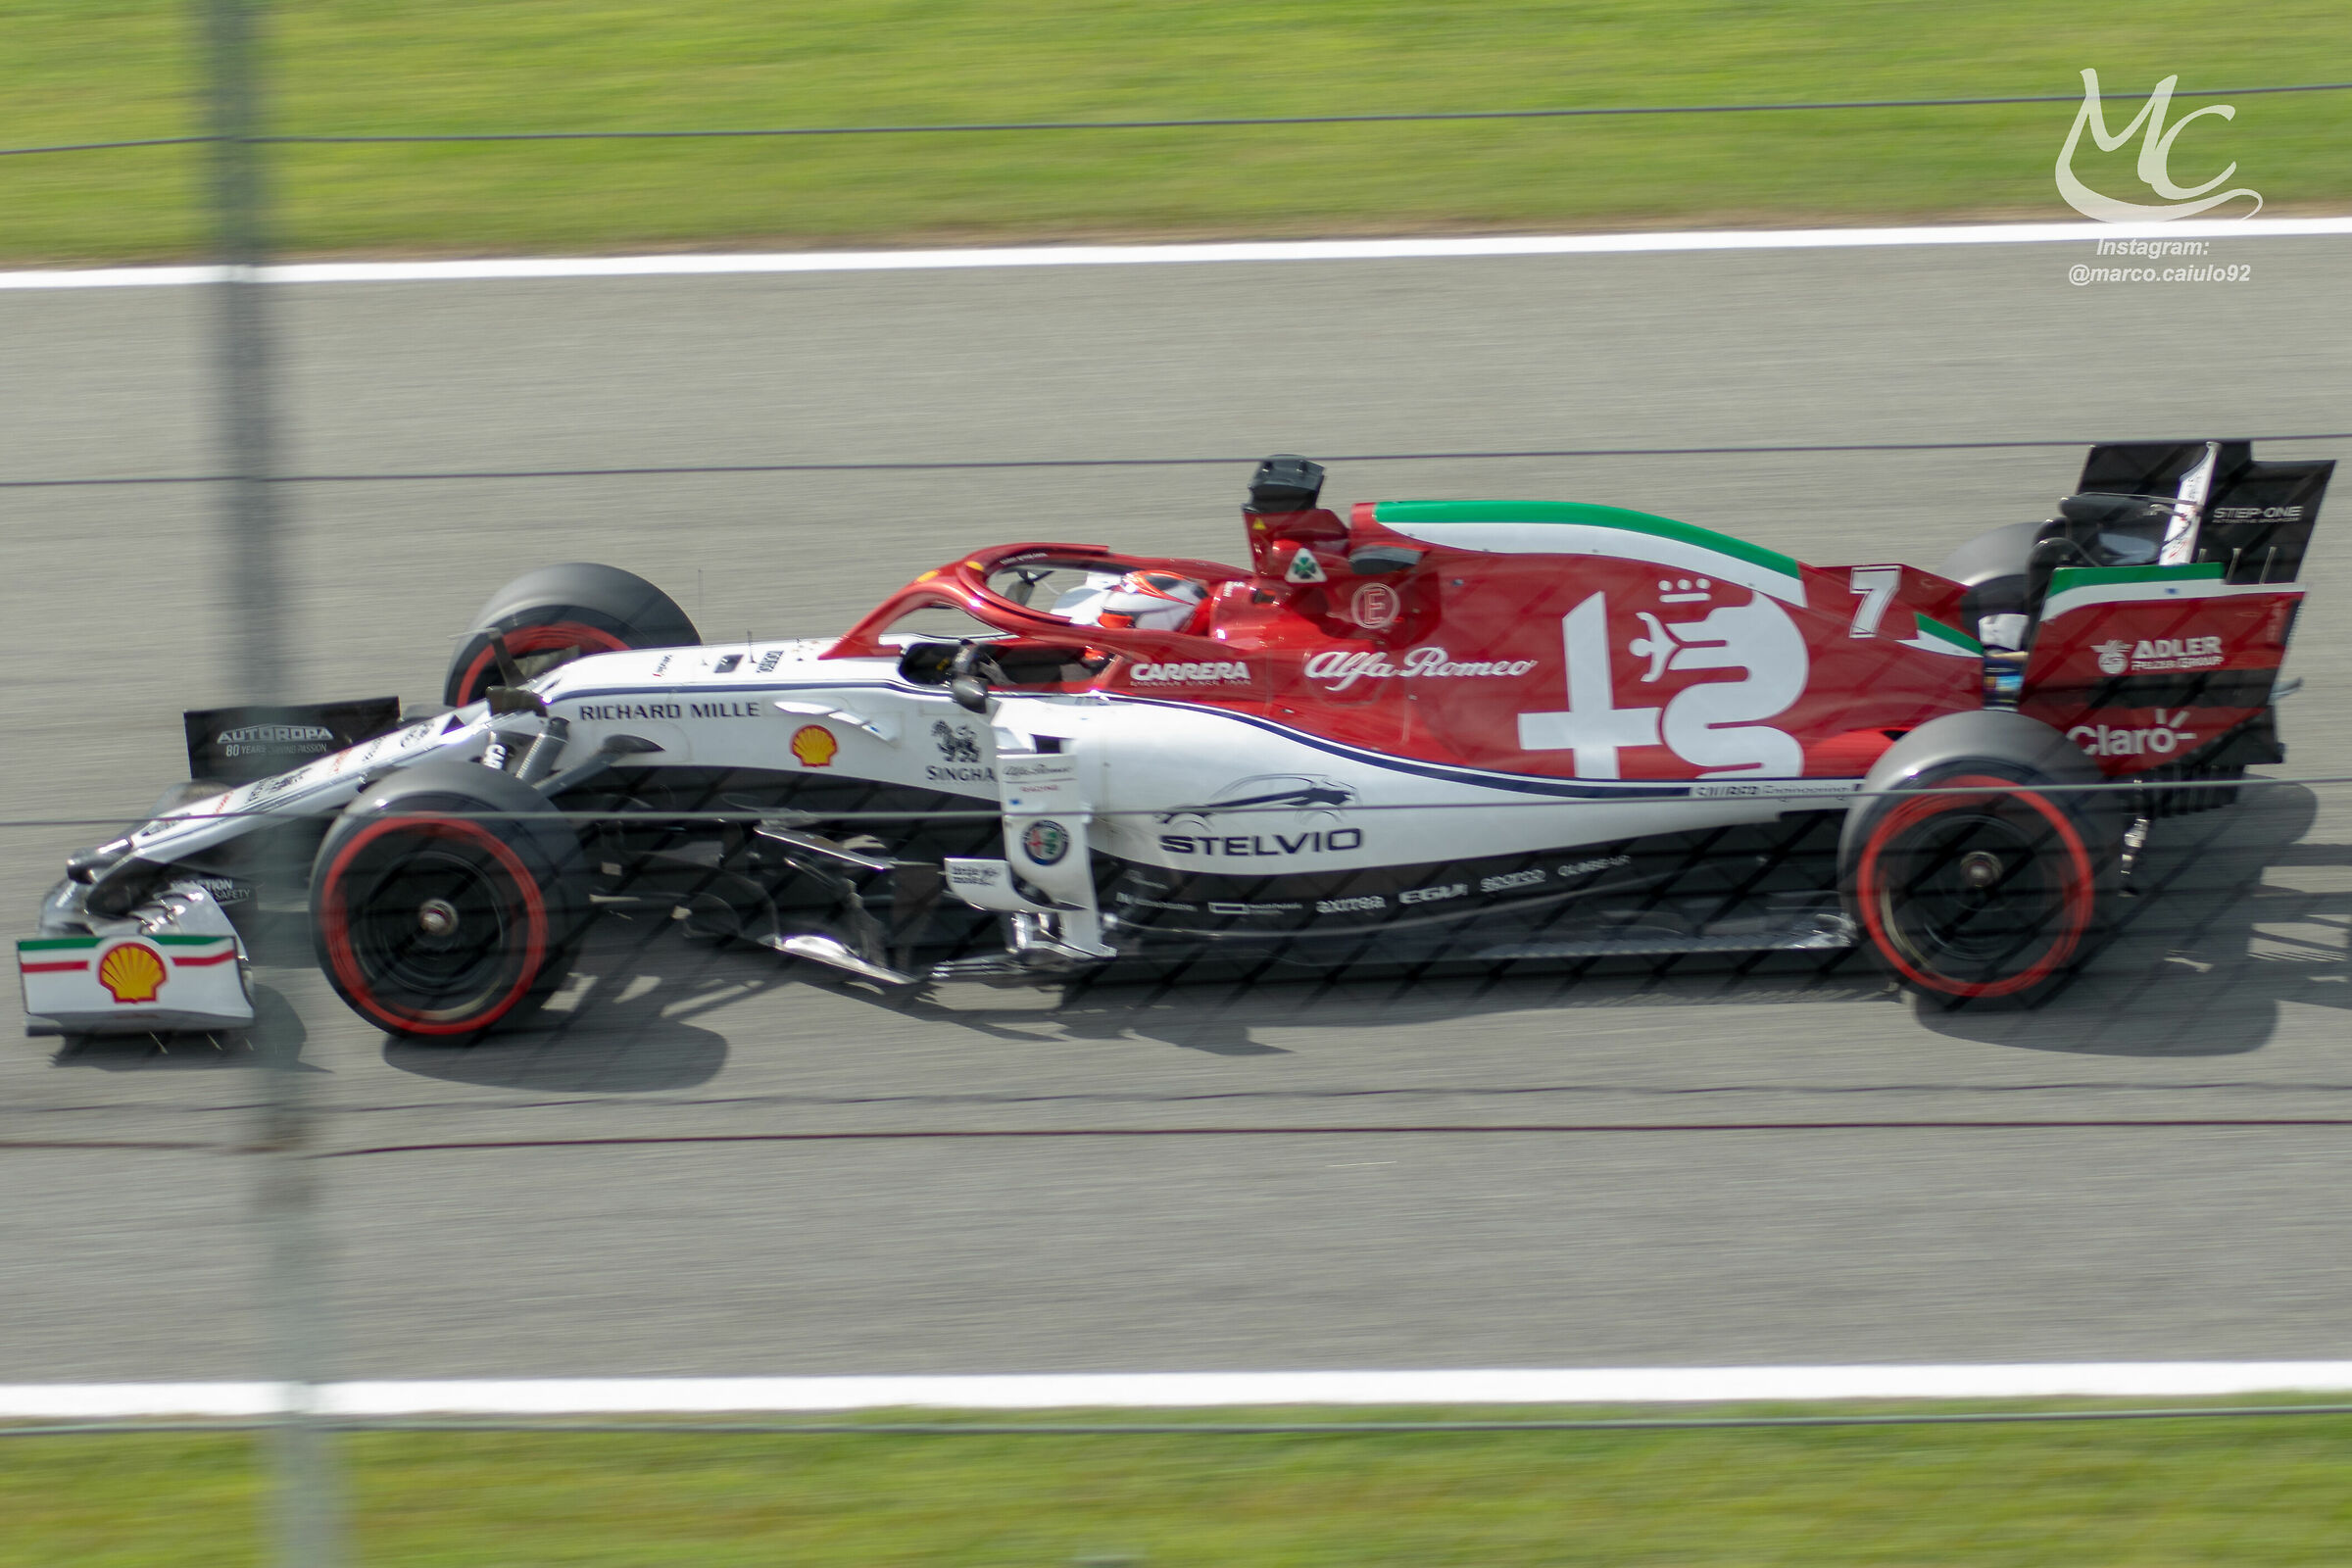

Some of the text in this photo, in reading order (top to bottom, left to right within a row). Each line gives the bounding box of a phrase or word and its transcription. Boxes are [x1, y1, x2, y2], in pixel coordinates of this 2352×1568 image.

[2213, 507, 2303, 518] STEP-ONE
[1849, 564, 1902, 638] 7
[2131, 636, 2223, 660] ADLER
[1129, 662, 1251, 681] CARRERA
[1304, 647, 1539, 691] Alfa Romeo
[580, 702, 761, 720] RICHARD MILLE
[217, 724, 333, 744] AUTOROPA
[2067, 724, 2178, 756] Claro
[225, 744, 240, 758] 80
[926, 765, 998, 782] SINGHA
[1158, 829, 1363, 858] STELVIO
